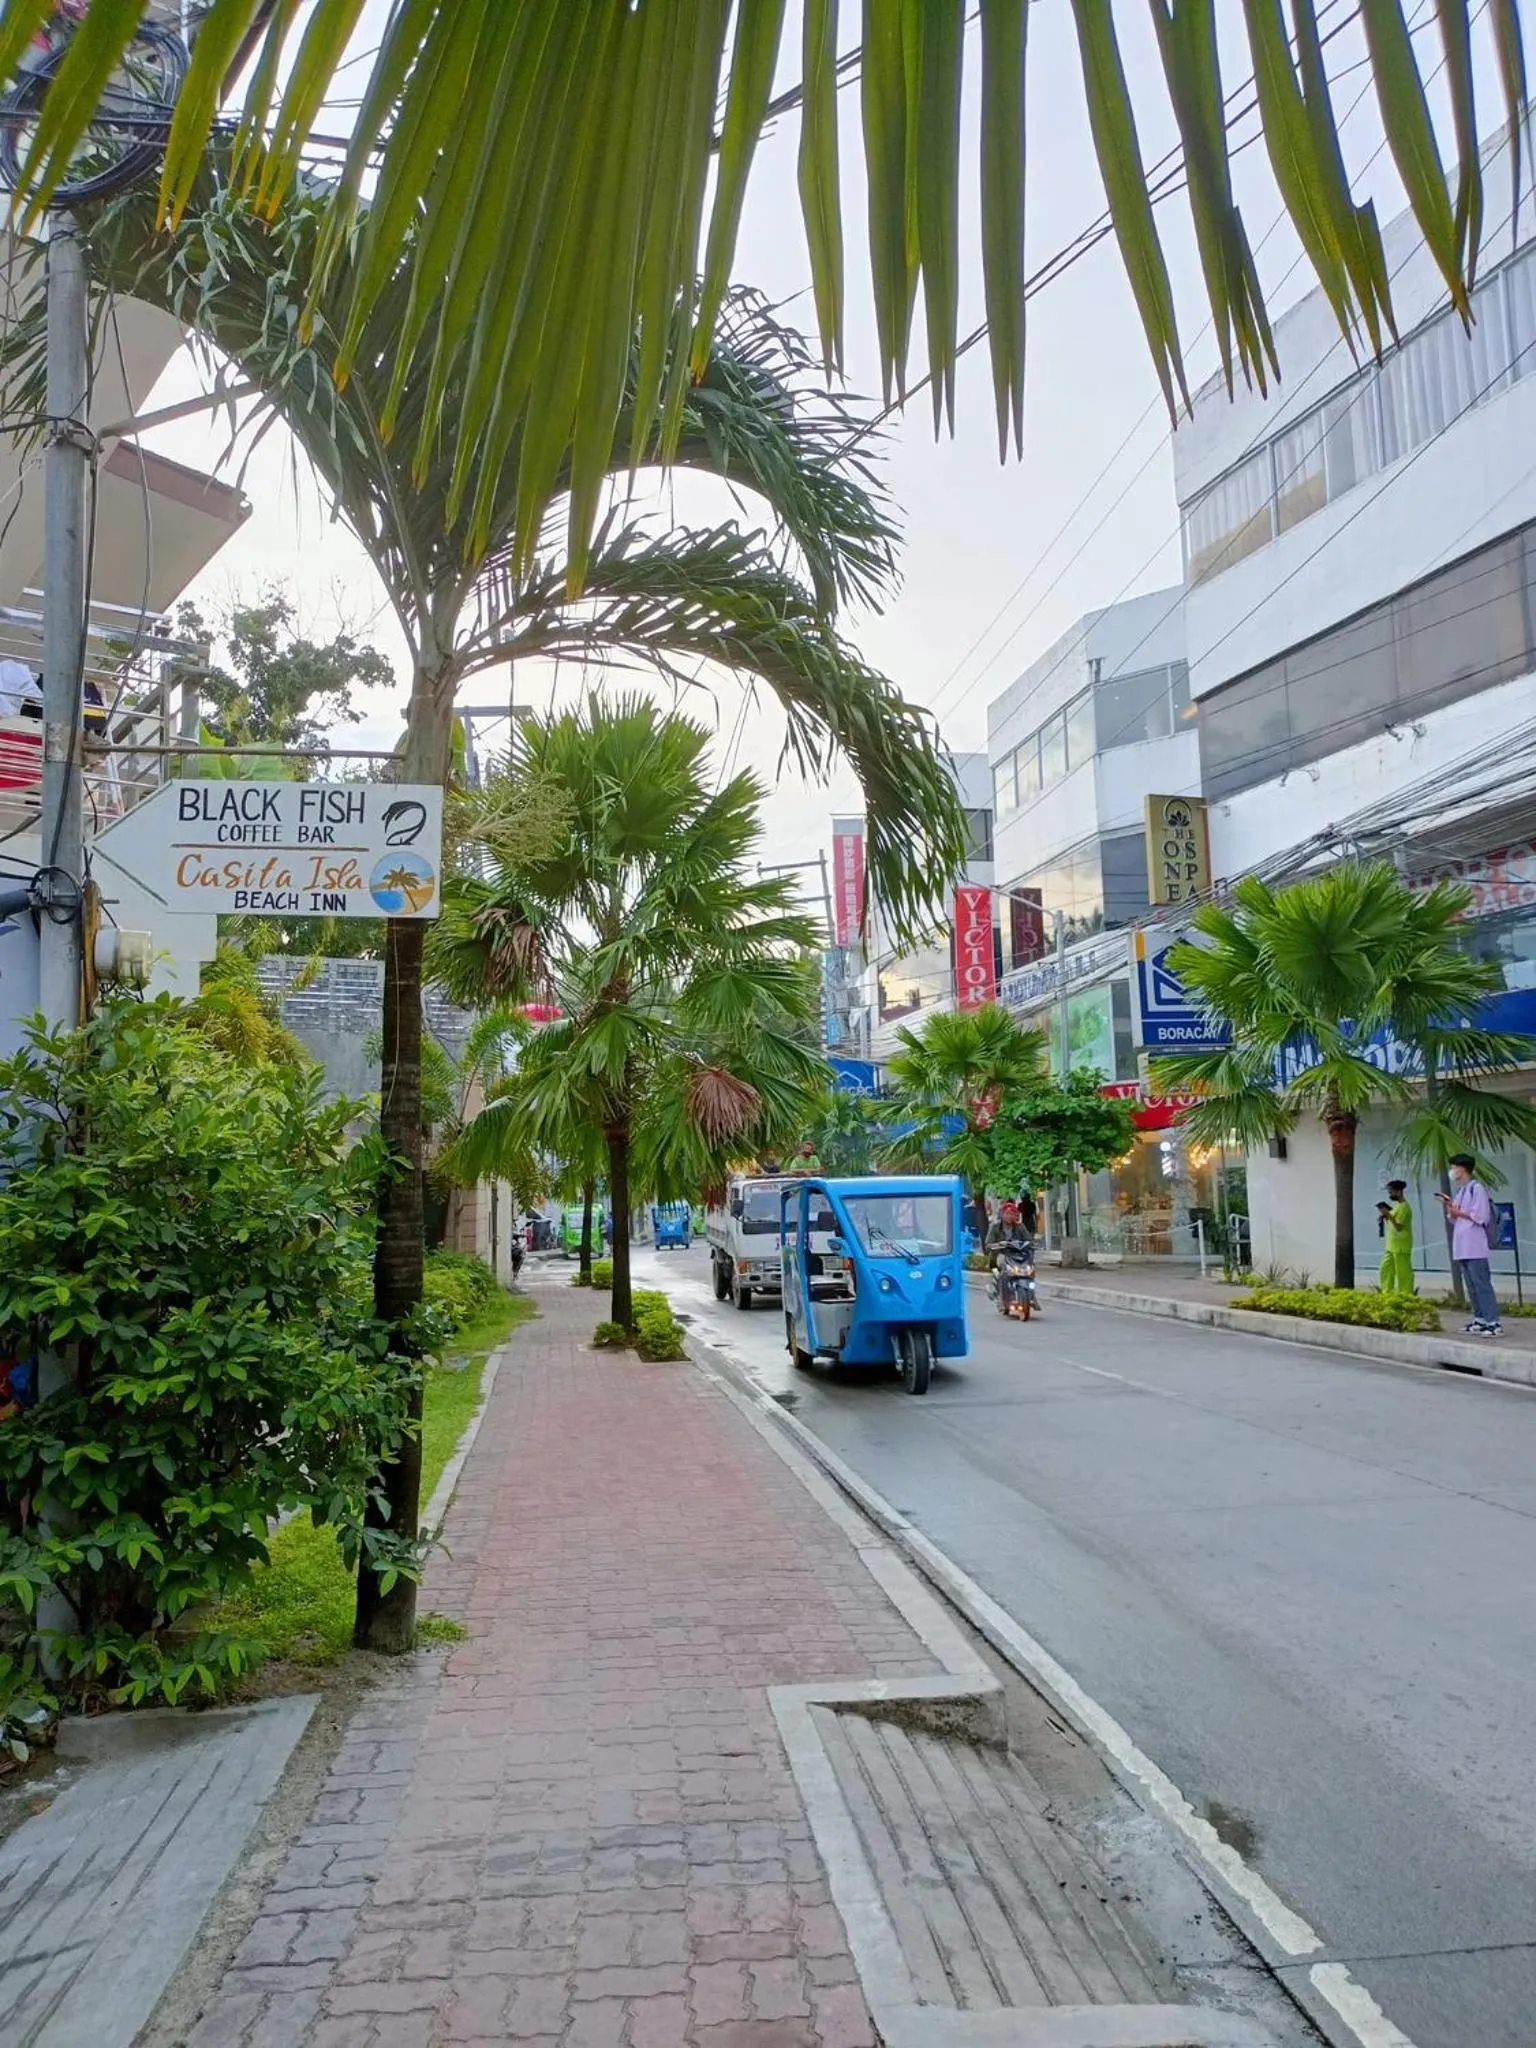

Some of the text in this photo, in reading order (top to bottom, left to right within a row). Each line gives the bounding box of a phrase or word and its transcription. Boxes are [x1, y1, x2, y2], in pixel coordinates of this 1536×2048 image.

[178, 787, 366, 824] BLACK FISH
[217, 823, 335, 843] COFFEE BAR
[176, 853, 366, 892] Casita Isla
[1163, 840, 1182, 902] ONE
[234, 890, 347, 912] BEACH INN
[1158, 1027, 1218, 1040] BORACAY
